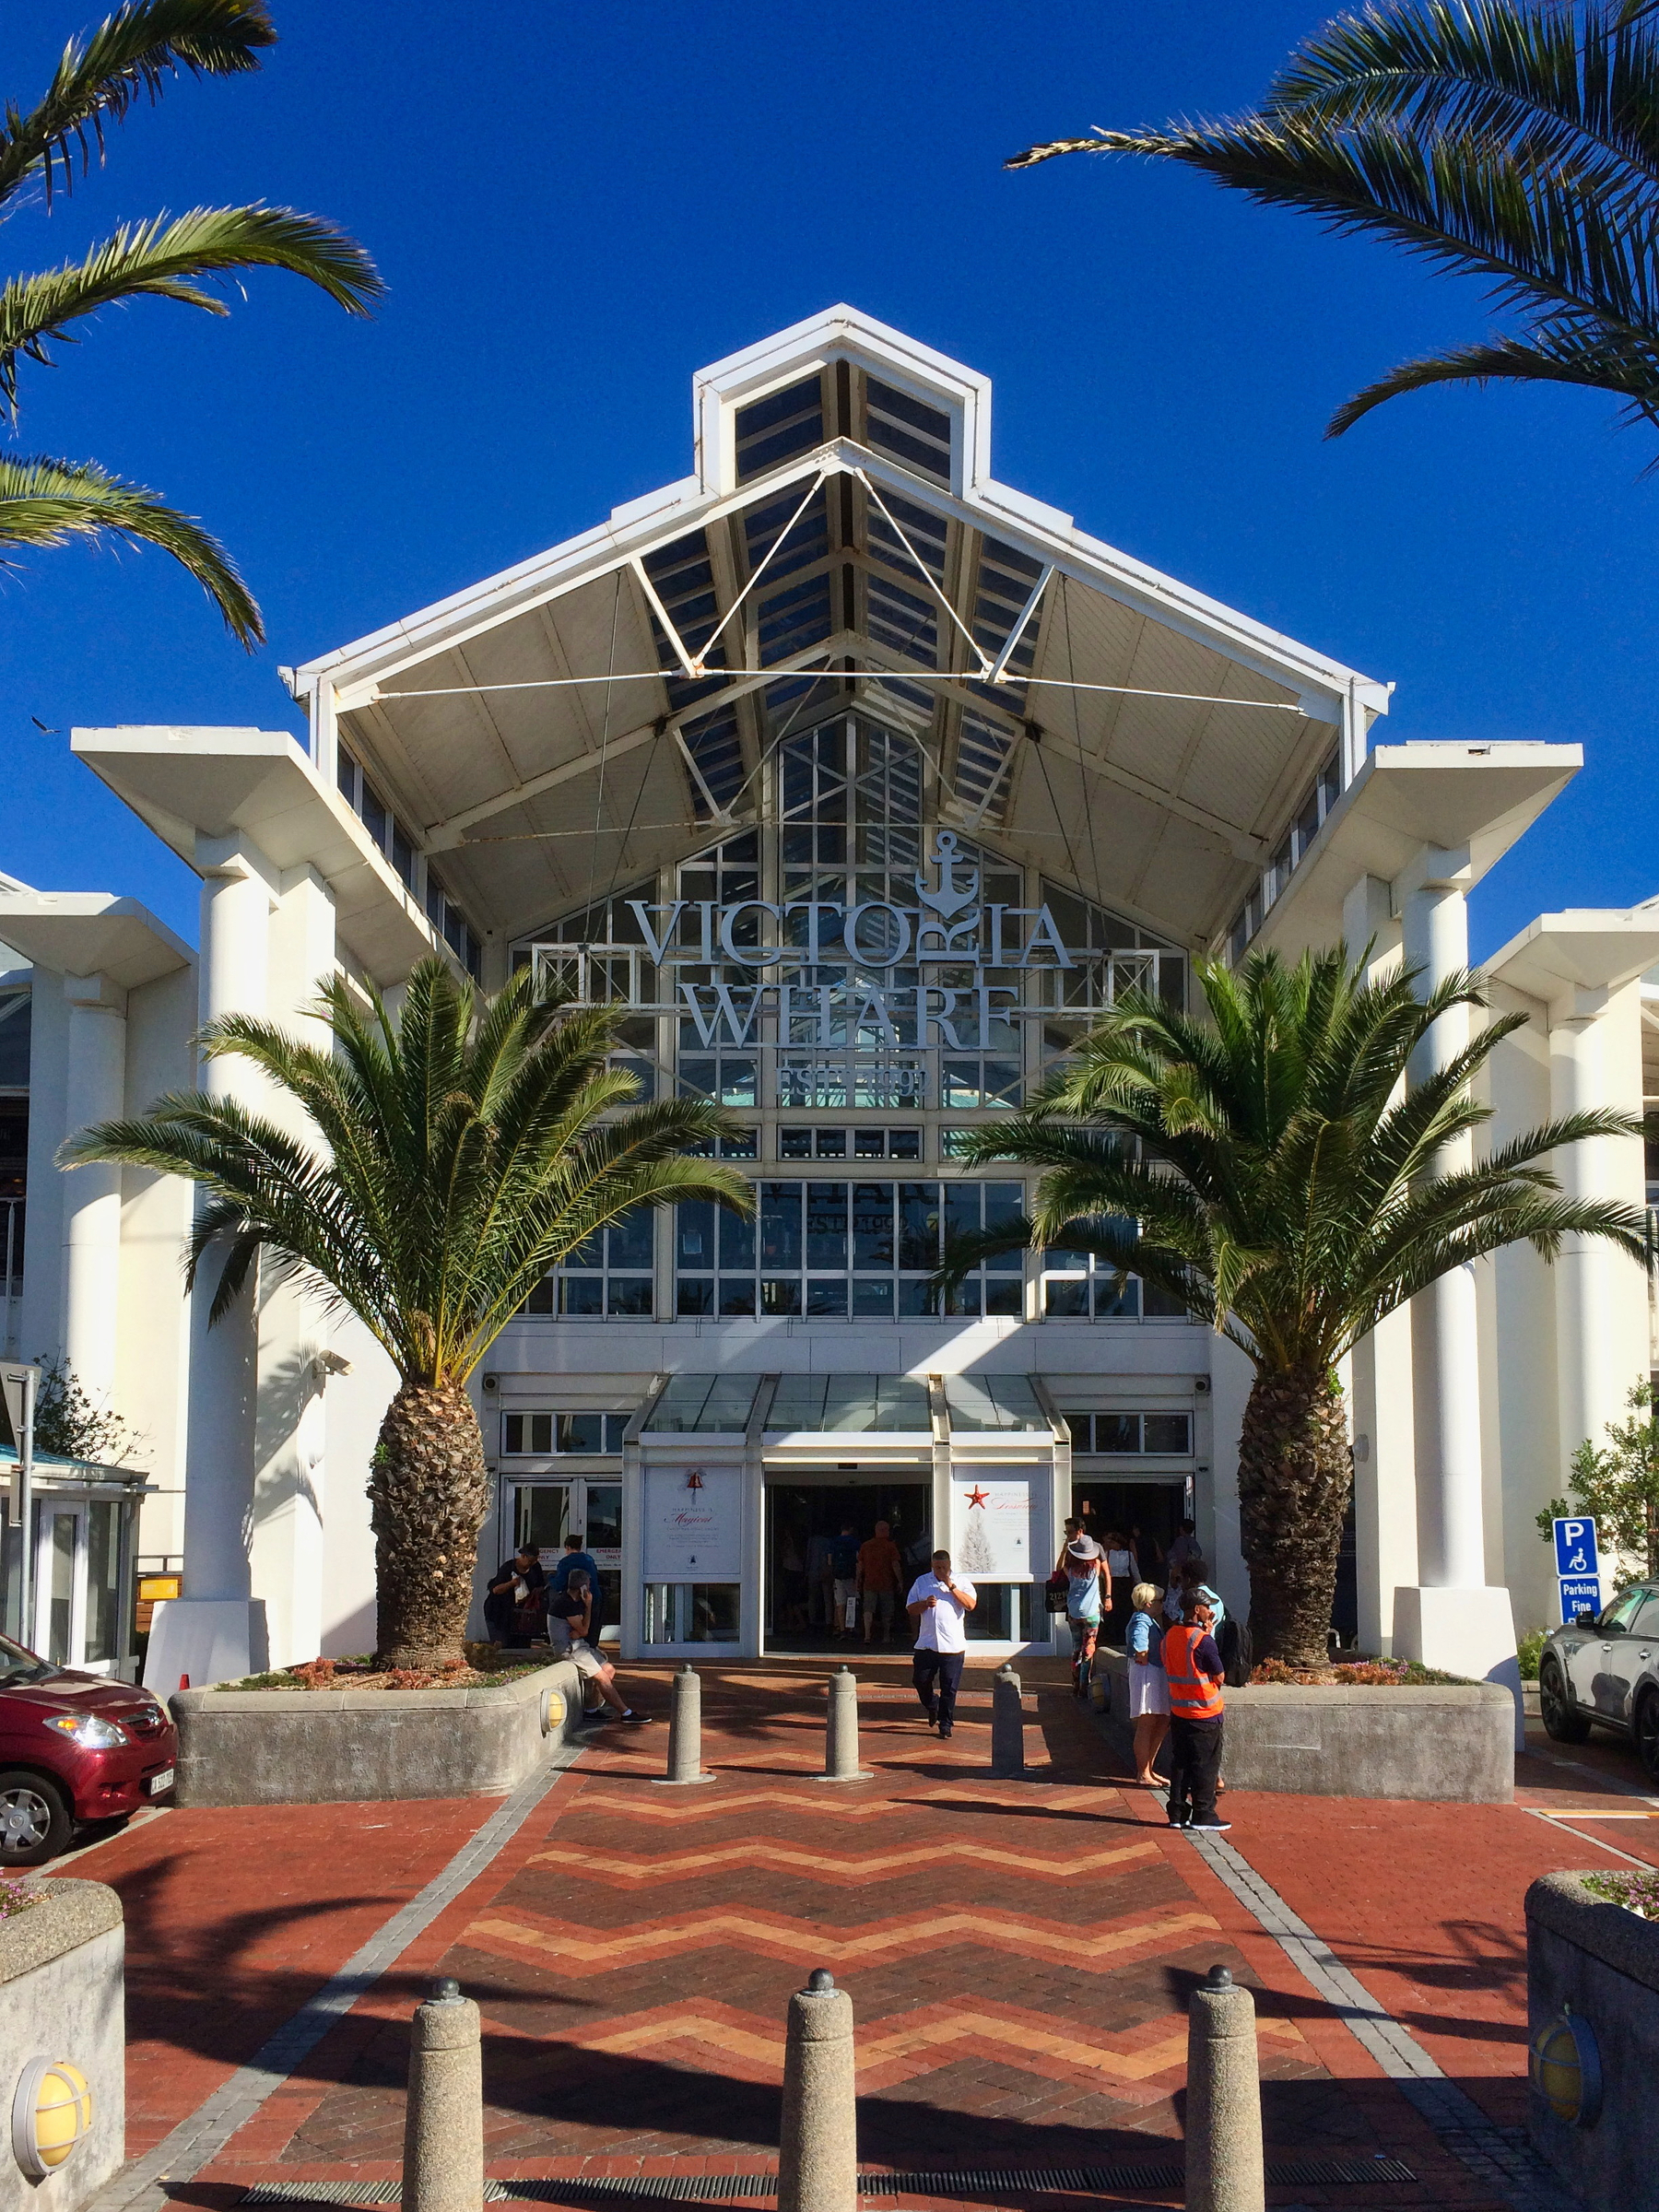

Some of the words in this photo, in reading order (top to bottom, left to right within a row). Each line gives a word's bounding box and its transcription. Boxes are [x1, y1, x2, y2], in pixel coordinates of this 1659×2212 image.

[624, 900, 1077, 969] VICTORIA
[676, 982, 1018, 1050] WHARF
[865, 1068, 932, 1097] 1992
[1564, 1523, 1584, 1547] P
[1563, 1583, 1597, 1597] Parking
[1571, 1600, 1592, 1612] Fine
